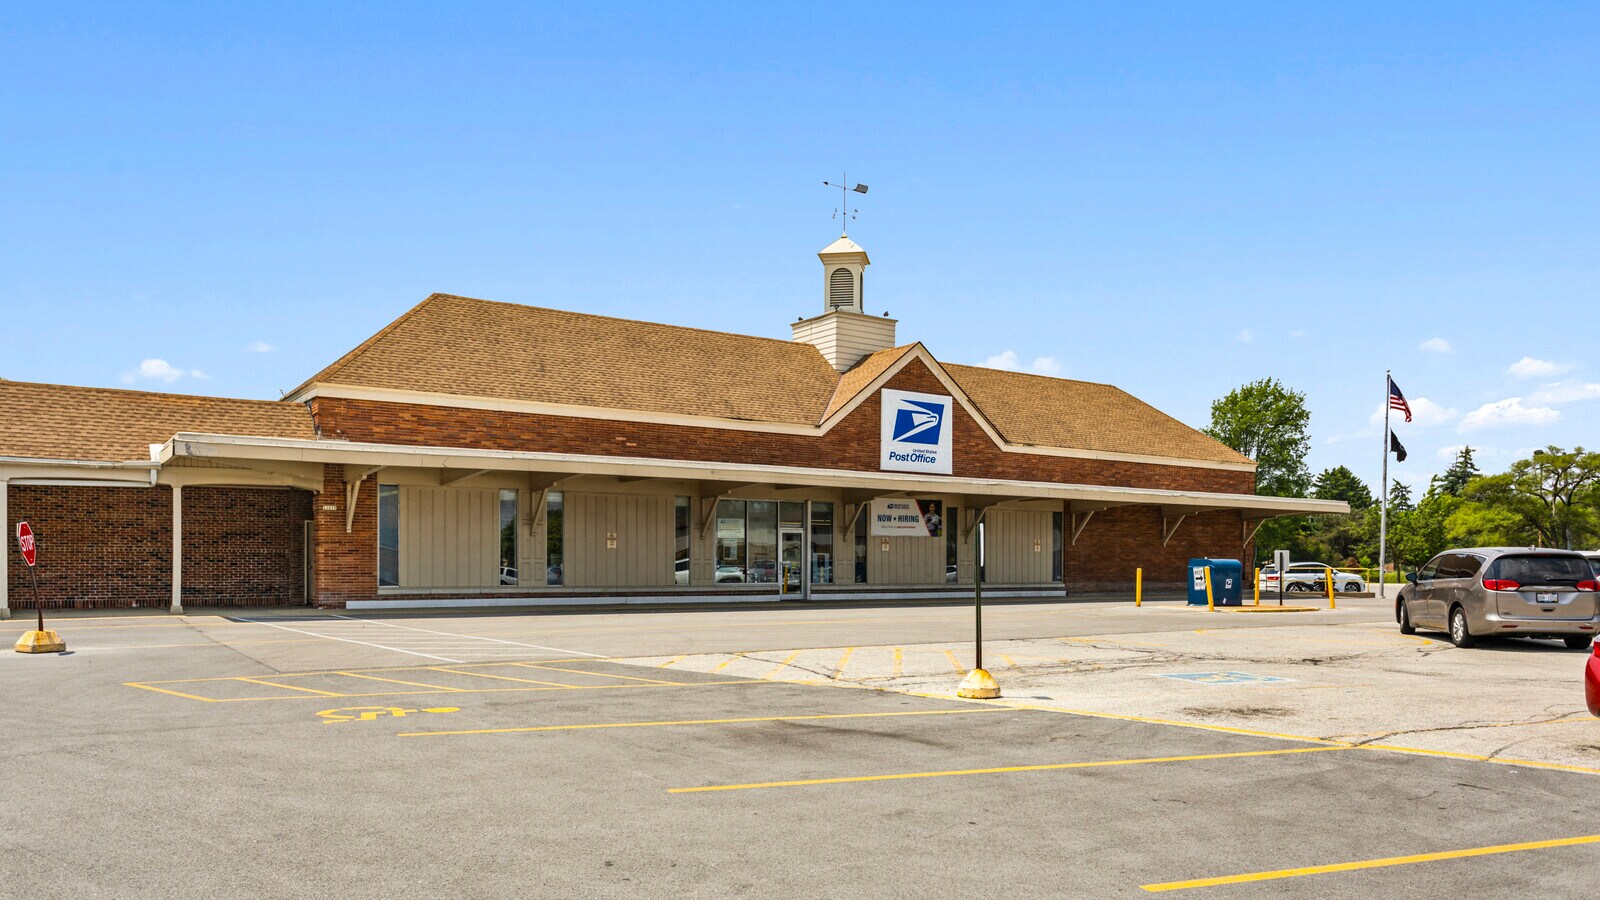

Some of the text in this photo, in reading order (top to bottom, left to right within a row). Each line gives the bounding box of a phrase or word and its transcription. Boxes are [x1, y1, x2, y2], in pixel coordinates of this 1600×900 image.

[889, 451, 936, 464] Post Office
[877, 514, 919, 523] NOW HIRING
[20, 534, 34, 552] STOP
